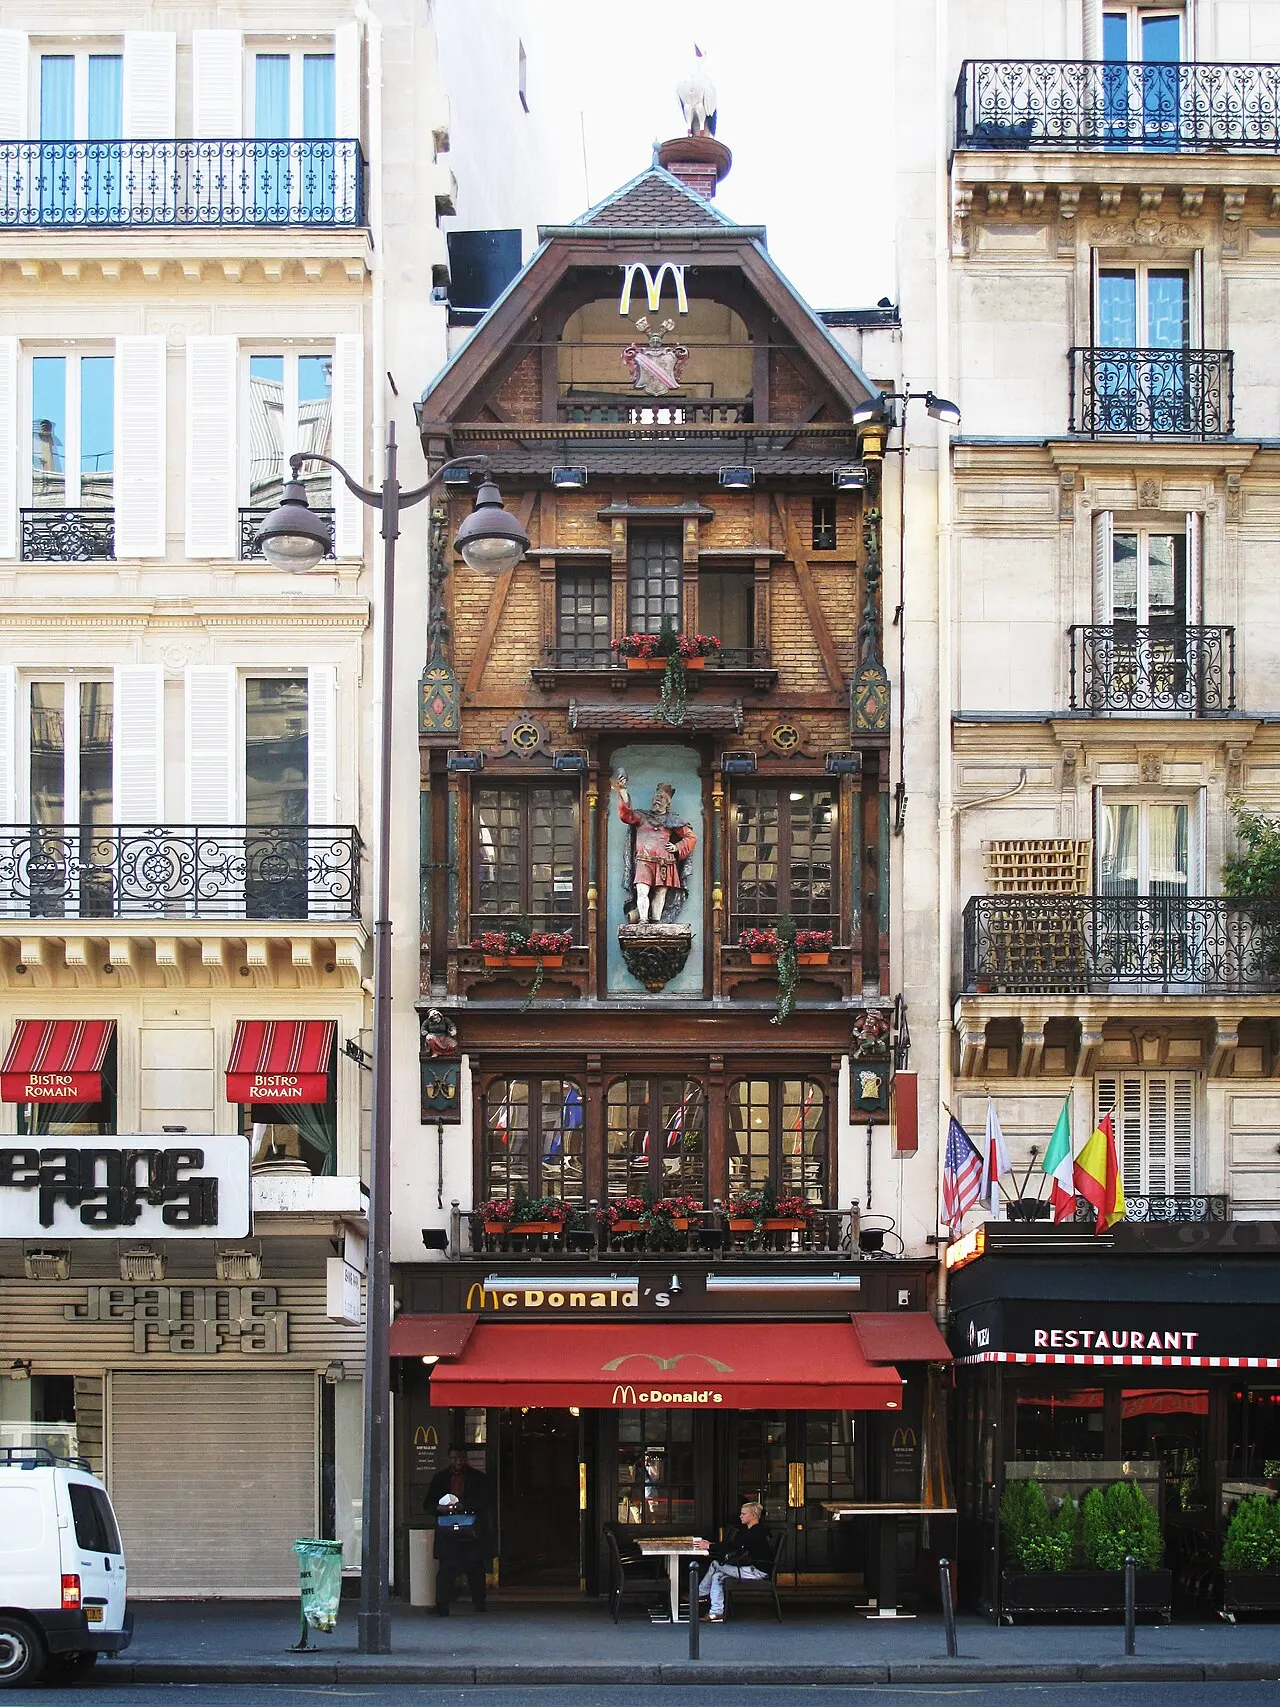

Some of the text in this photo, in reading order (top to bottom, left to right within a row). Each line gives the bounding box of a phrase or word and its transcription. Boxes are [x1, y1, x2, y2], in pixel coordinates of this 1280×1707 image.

[29, 1073, 73, 1086] BISTRO
[254, 1074, 298, 1087] BISTRO
[24, 1085, 78, 1098] ROMAIN
[249, 1086, 303, 1098] ROMAIN
[63, 1286, 278, 1321] Jeanne
[466, 1283, 671, 1310] McDonald's
[1033, 1329, 1199, 1350] RESTAURANT
[612, 1385, 723, 1404] McDonald's
